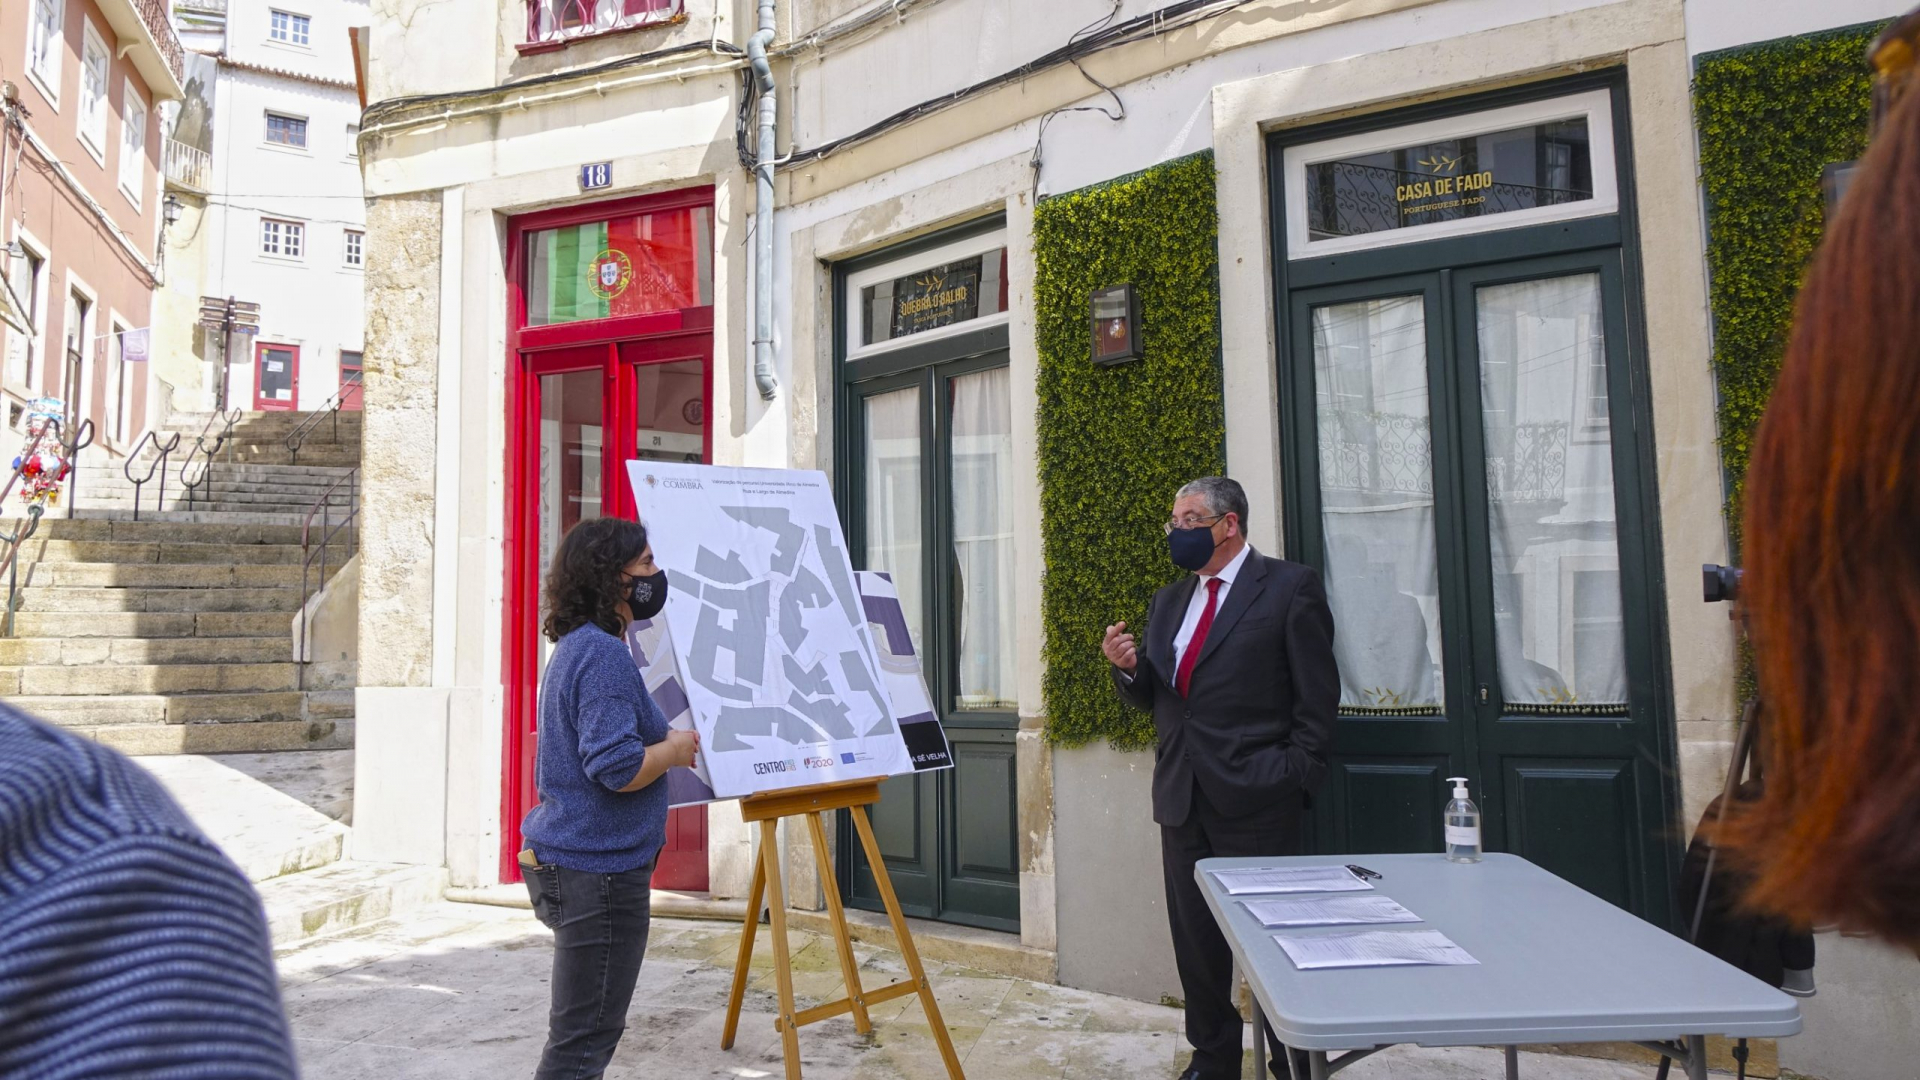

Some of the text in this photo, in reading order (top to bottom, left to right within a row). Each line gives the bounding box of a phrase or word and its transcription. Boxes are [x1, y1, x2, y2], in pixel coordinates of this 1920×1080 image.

[587, 165, 606, 187] 18
[1396, 171, 1492, 202] CASA DE FADO
[1404, 196, 1486, 214] PORTUGUESE FADO
[901, 296, 931, 316] QUEBRA
[663, 480, 704, 490] COIMBRA
[811, 758, 834, 769] 2020
[917, 753, 926, 762] SÉ
[926, 751, 947, 761] VELHA
[753, 760, 786, 775] CENTRO
